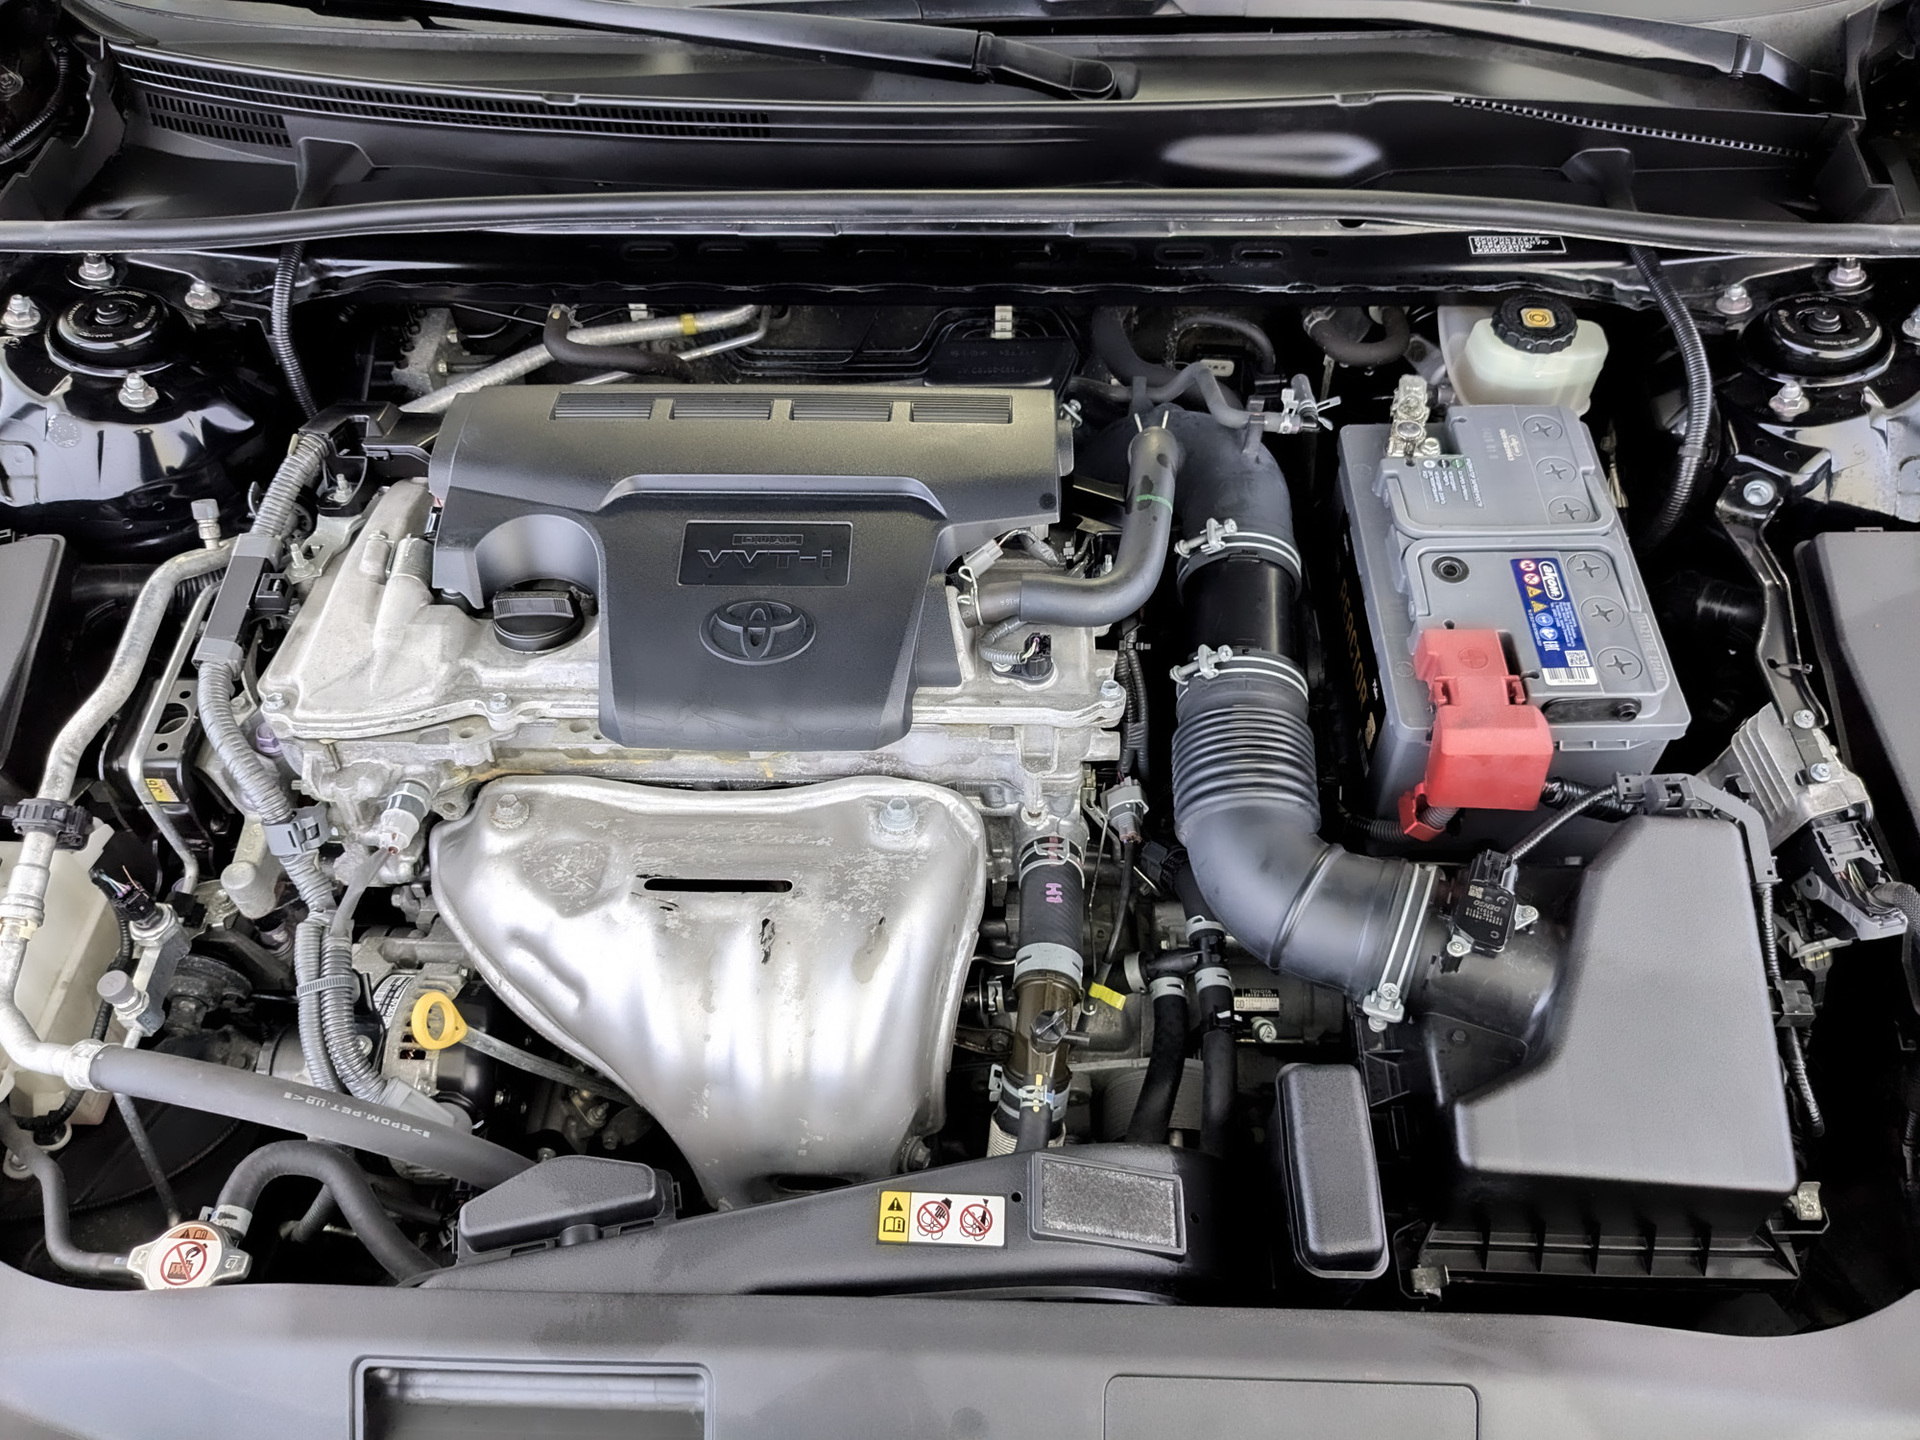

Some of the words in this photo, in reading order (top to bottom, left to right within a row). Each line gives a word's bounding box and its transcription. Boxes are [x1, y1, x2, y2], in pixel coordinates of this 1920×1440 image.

[741, 535, 797, 545] DUAL
[697, 549, 833, 569] VVT-i
[1340, 577, 1369, 712] REACTOR
[1045, 882, 1064, 904] H1
[1473, 900, 1501, 912] DENSO
